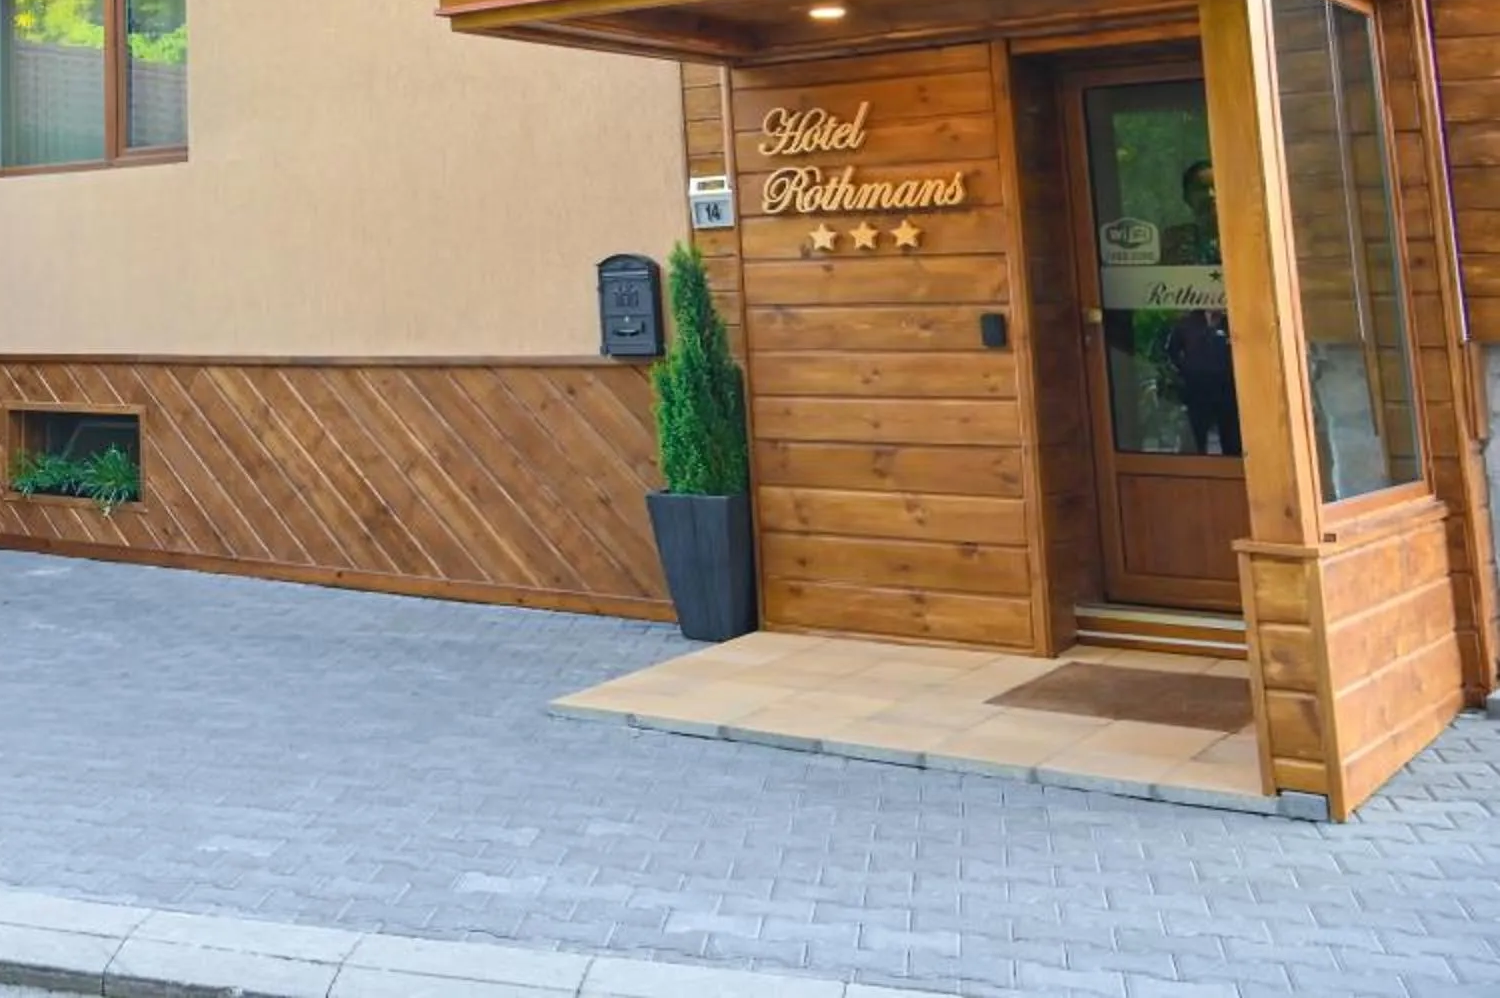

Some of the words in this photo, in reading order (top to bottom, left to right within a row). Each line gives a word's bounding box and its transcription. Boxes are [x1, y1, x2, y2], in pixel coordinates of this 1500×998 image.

[759, 102, 870, 154] Hotel
[706, 203, 720, 221] 14
[762, 165, 965, 214] Rothmans
